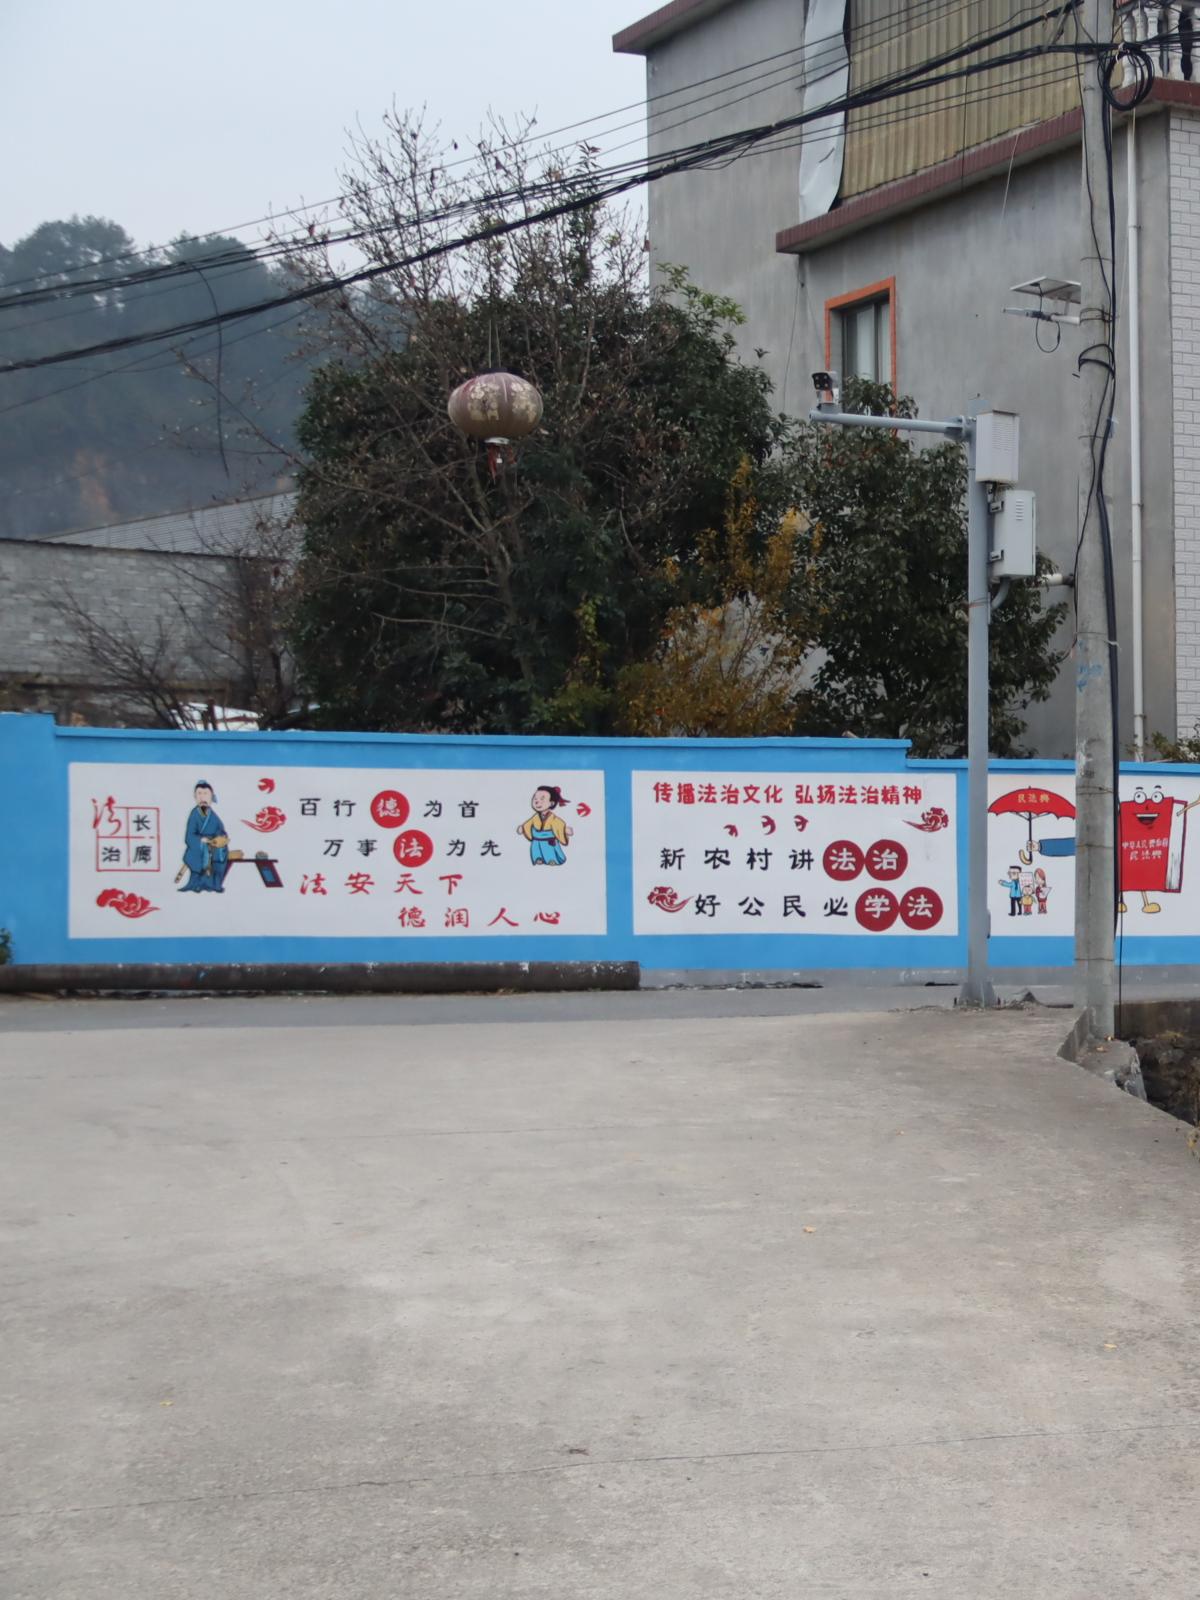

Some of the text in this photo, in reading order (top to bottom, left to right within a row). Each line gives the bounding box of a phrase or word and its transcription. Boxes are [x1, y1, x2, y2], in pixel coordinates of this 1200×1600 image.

[653, 782, 923, 806] 传播法治文化 弘扬法治精神
[300, 797, 479, 818] 百行德为首
[323, 837, 502, 859] 万事法为先
[660, 847, 900, 872] 新农村讲法治
[300, 873, 463, 896] 法安天下
[398, 906, 561, 928] 德润人心
[695, 893, 935, 920] 好公民必学法
